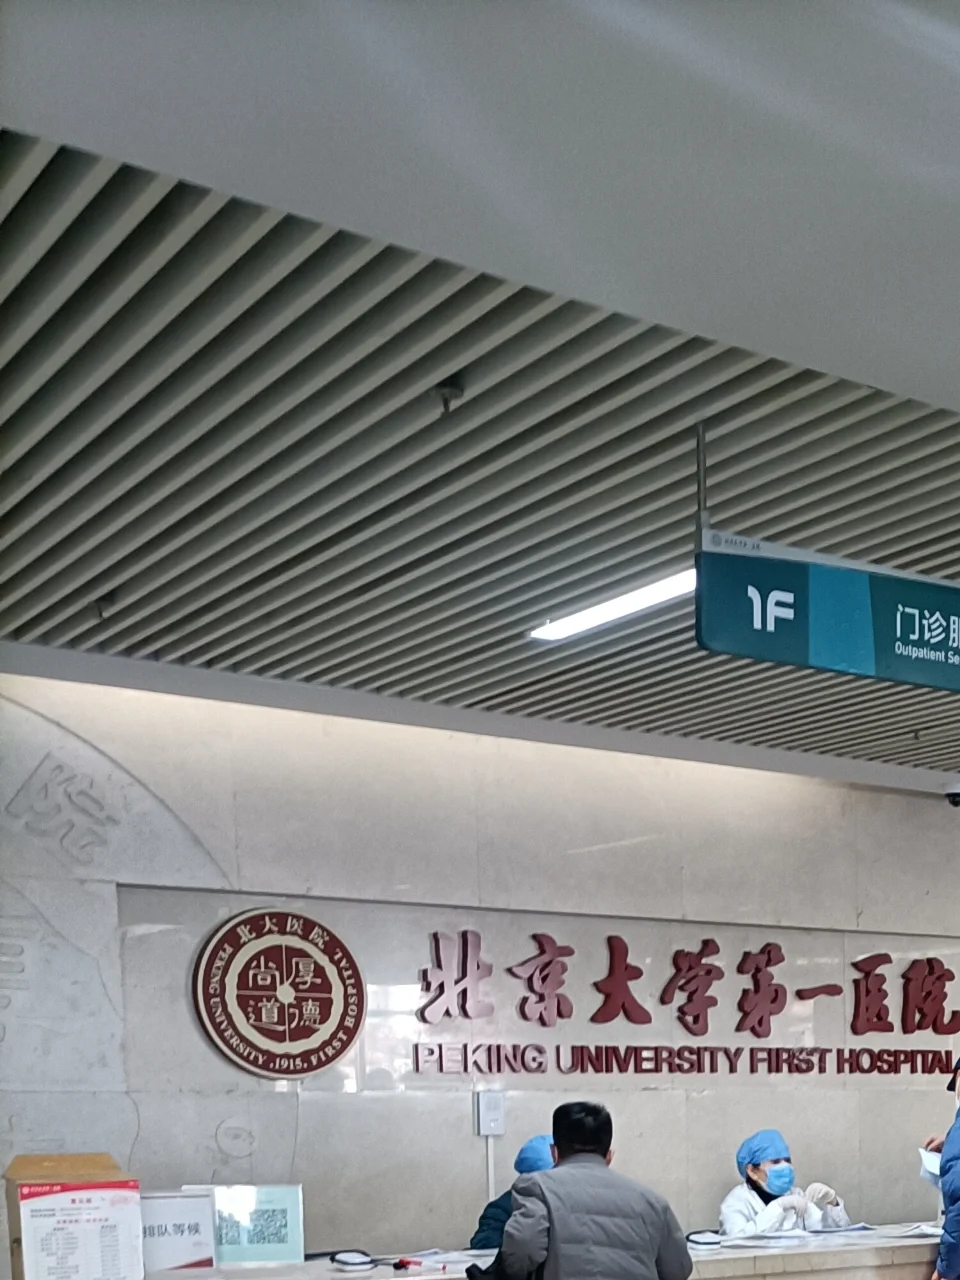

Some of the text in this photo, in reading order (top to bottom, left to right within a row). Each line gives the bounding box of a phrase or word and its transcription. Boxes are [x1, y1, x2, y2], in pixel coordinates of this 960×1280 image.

[748, 584, 795, 632] 1F
[895, 641, 945, 660] Outpatient
[209, 943, 234, 995] PEKING
[333, 948, 359, 1029] HOSPITAL
[210, 996, 268, 1065] UNIVERSITY
[310, 1030, 348, 1066] FIRST
[412, 1043, 956, 1075] PEKING UNIVERSITY FIRST HOSPITAL
